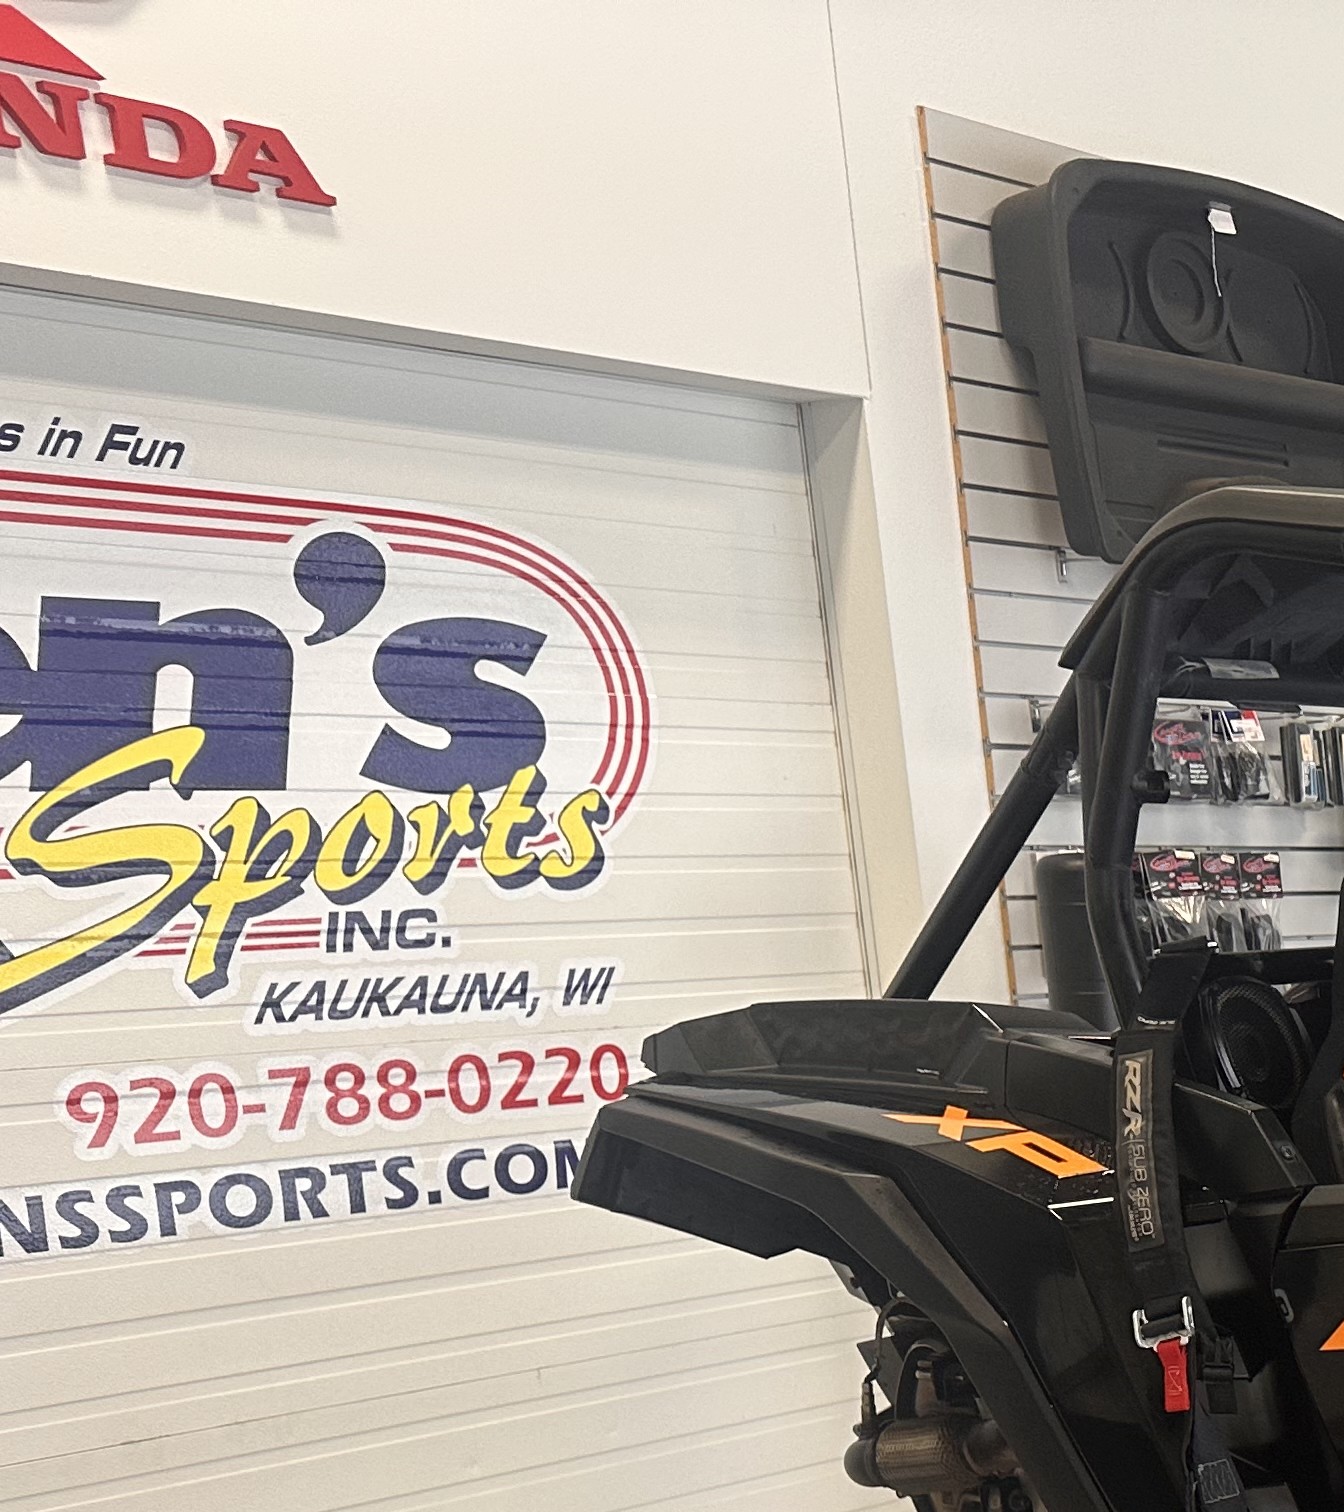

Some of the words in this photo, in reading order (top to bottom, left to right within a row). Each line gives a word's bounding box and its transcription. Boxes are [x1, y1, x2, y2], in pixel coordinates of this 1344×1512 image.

[37, 416, 83, 459] in
[95, 423, 186, 469] Fun
[0, 531, 548, 794] n's
[0, 724, 611, 1016] Sports
[325, 909, 452, 953] INC.
[255, 971, 541, 1026] KAUKAUNA,
[562, 965, 616, 1006] WI
[65, 1042, 630, 1150] 920-788-0220
[1122, 1059, 1144, 1138] RZR
[1132, 1144, 1148, 1183] SUB
